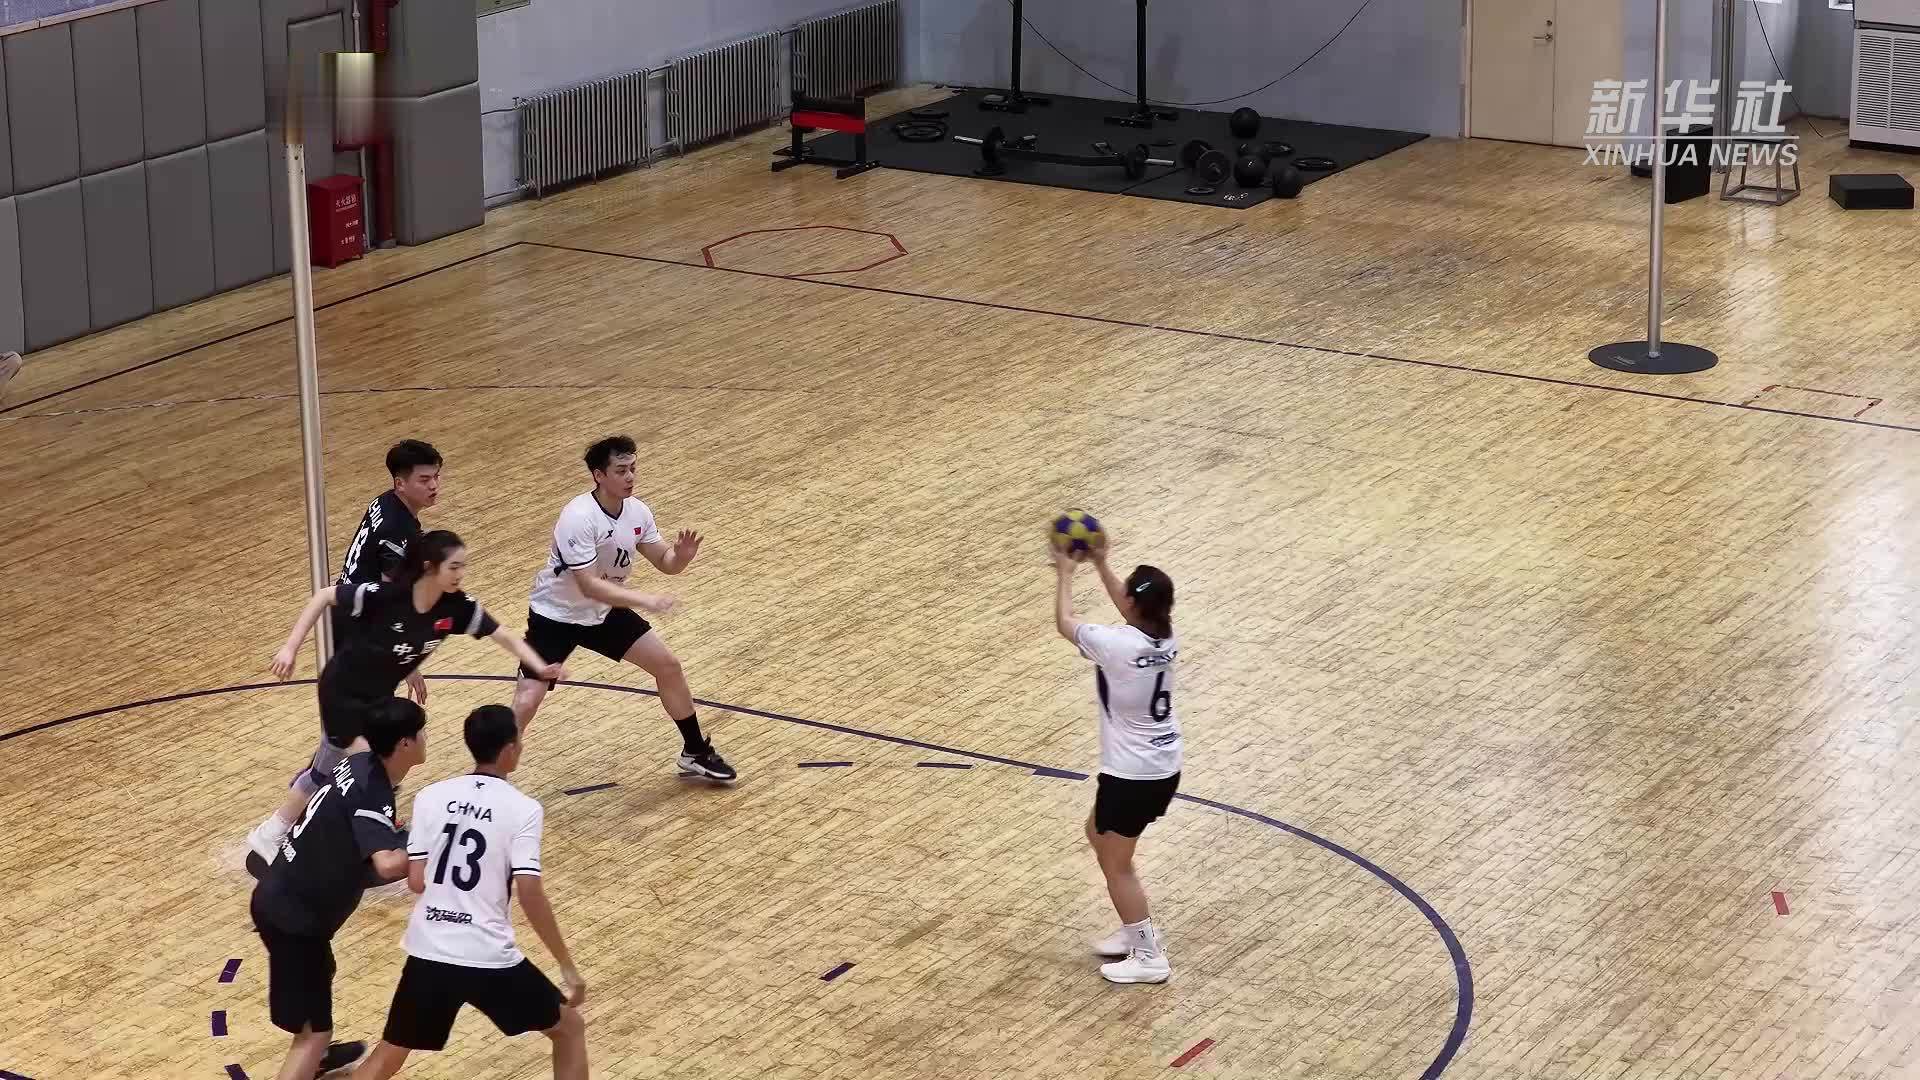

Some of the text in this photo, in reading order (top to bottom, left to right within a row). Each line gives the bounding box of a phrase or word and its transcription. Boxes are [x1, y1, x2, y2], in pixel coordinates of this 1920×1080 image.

[1150, 671, 1172, 722] 6
[292, 783, 332, 840] 9
[433, 823, 487, 892] 13
